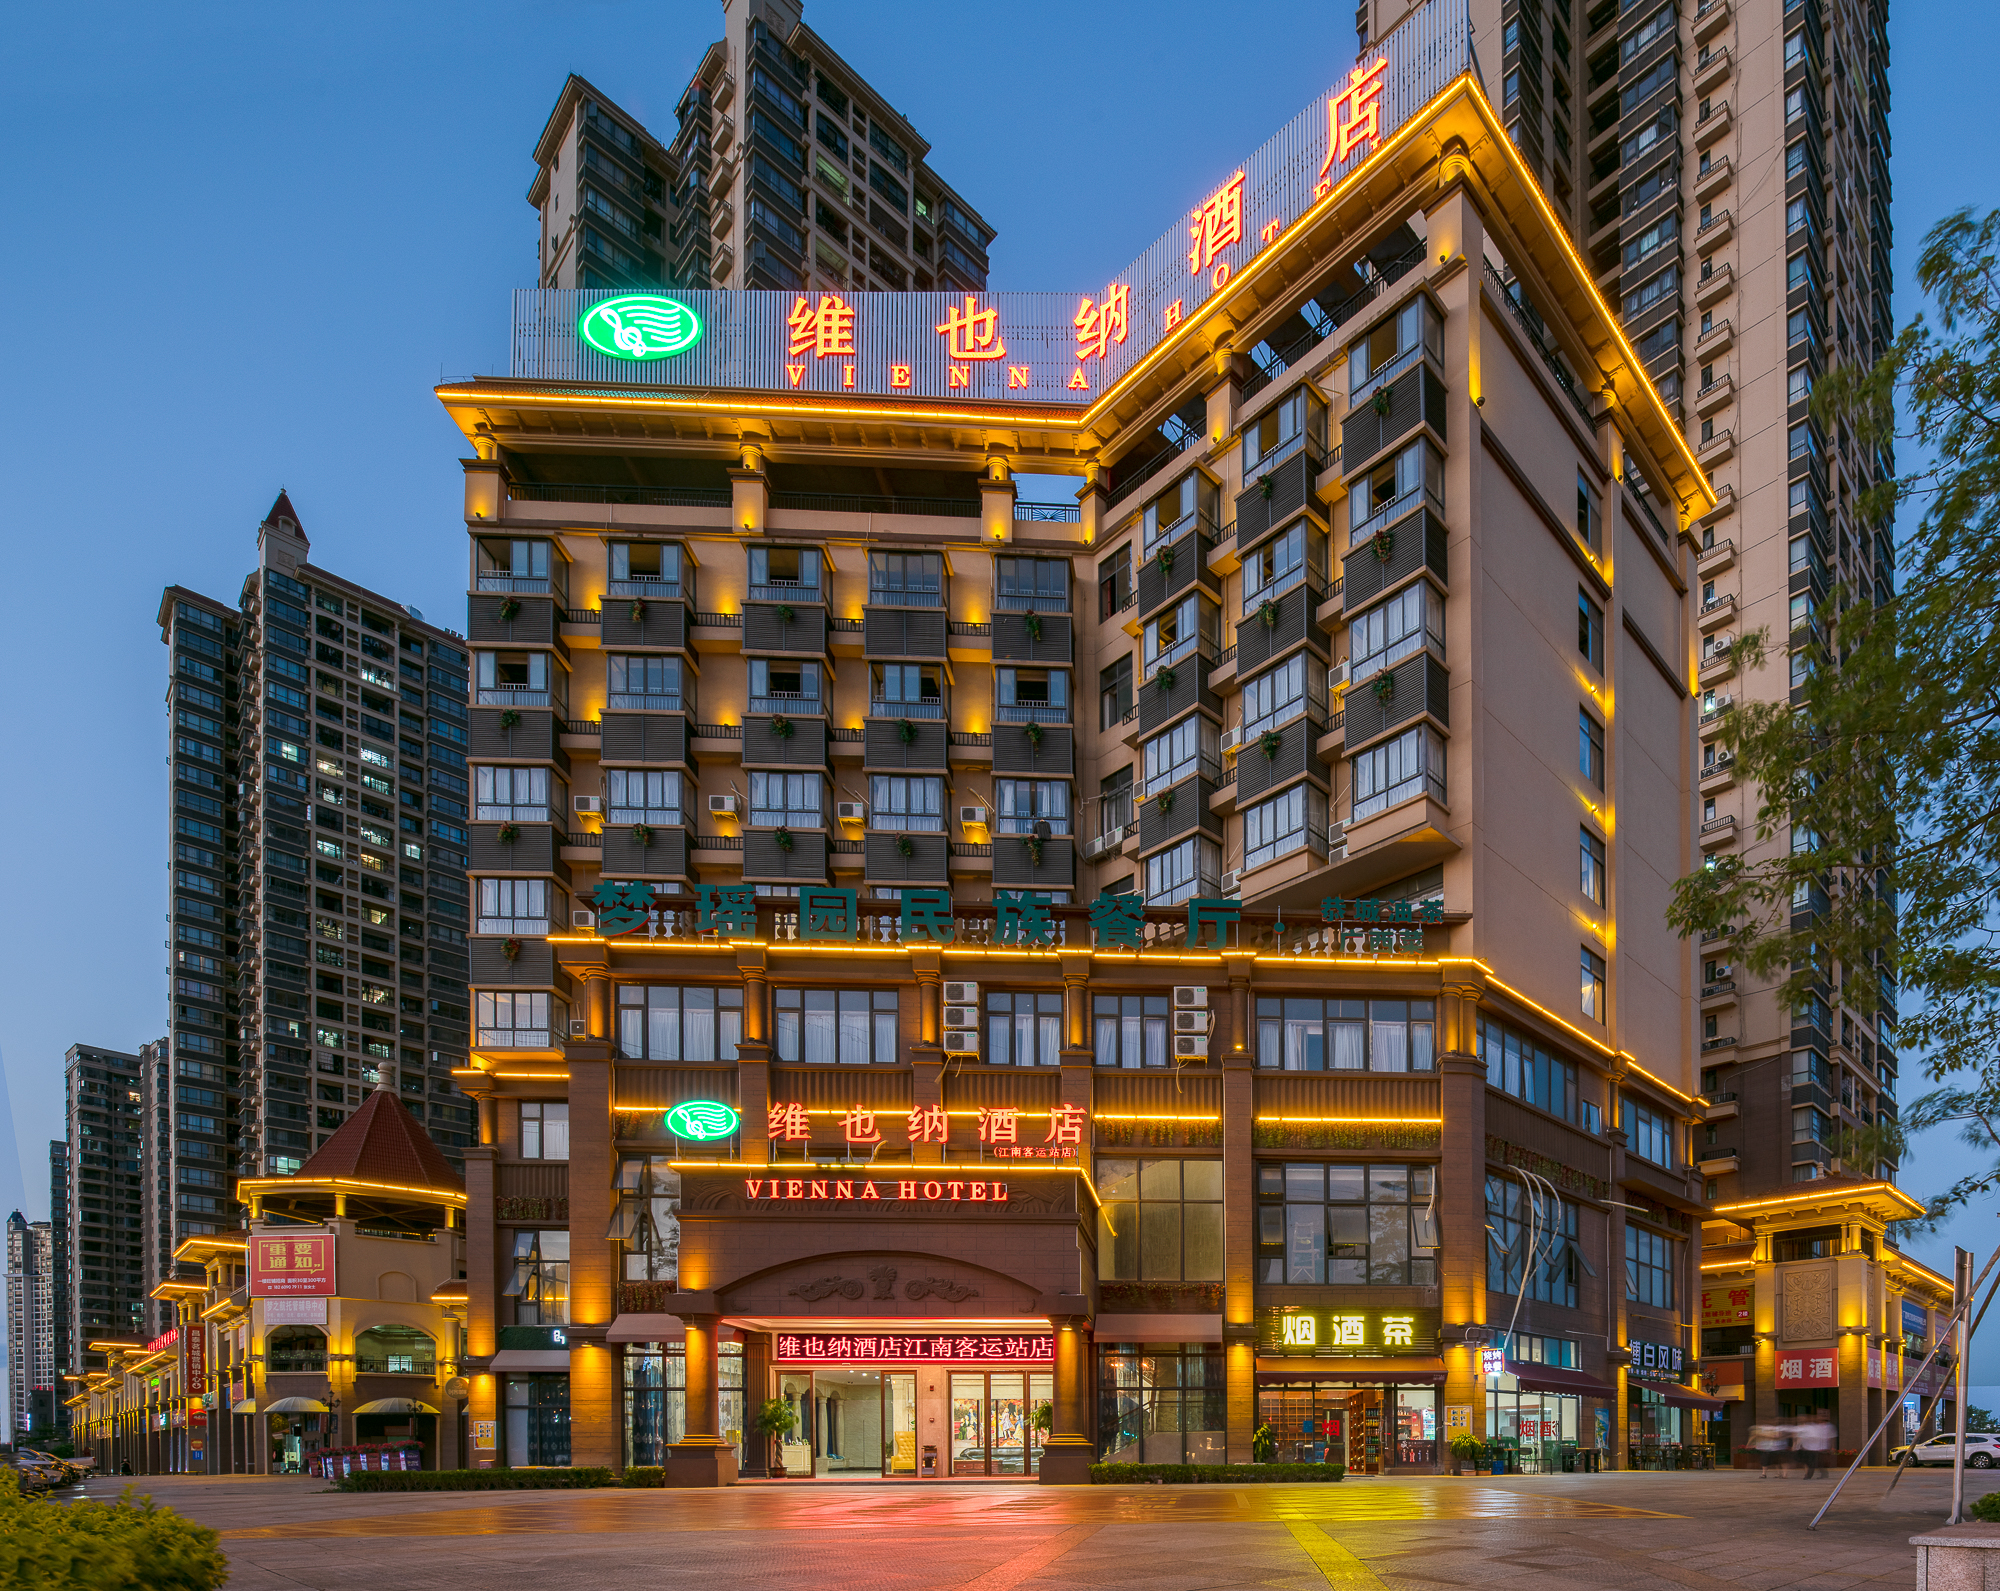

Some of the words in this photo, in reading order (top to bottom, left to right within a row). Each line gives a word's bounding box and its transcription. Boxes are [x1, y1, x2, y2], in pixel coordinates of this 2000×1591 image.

[786, 365, 1090, 391] VIENNA
[592, 880, 1243, 951] 梦瑶园民族餐厅
[1320, 896, 1445, 924] 恭城油茶
[1340, 929, 1425, 956] 广西菜
[767, 1102, 1087, 1144] 维也纳酒店
[746, 1179, 880, 1200] VIENNA
[898, 1180, 1008, 1202] HOTEL
[1282, 1316, 1414, 1345] 烟酒茶
[779, 1336, 1053, 1358] 维也纳酒店江南客运站店
[1629, 1339, 1682, 1371] 博白风味
[1779, 1357, 1833, 1380] 烟酒
[1321, 1419, 1340, 1436] 烟
